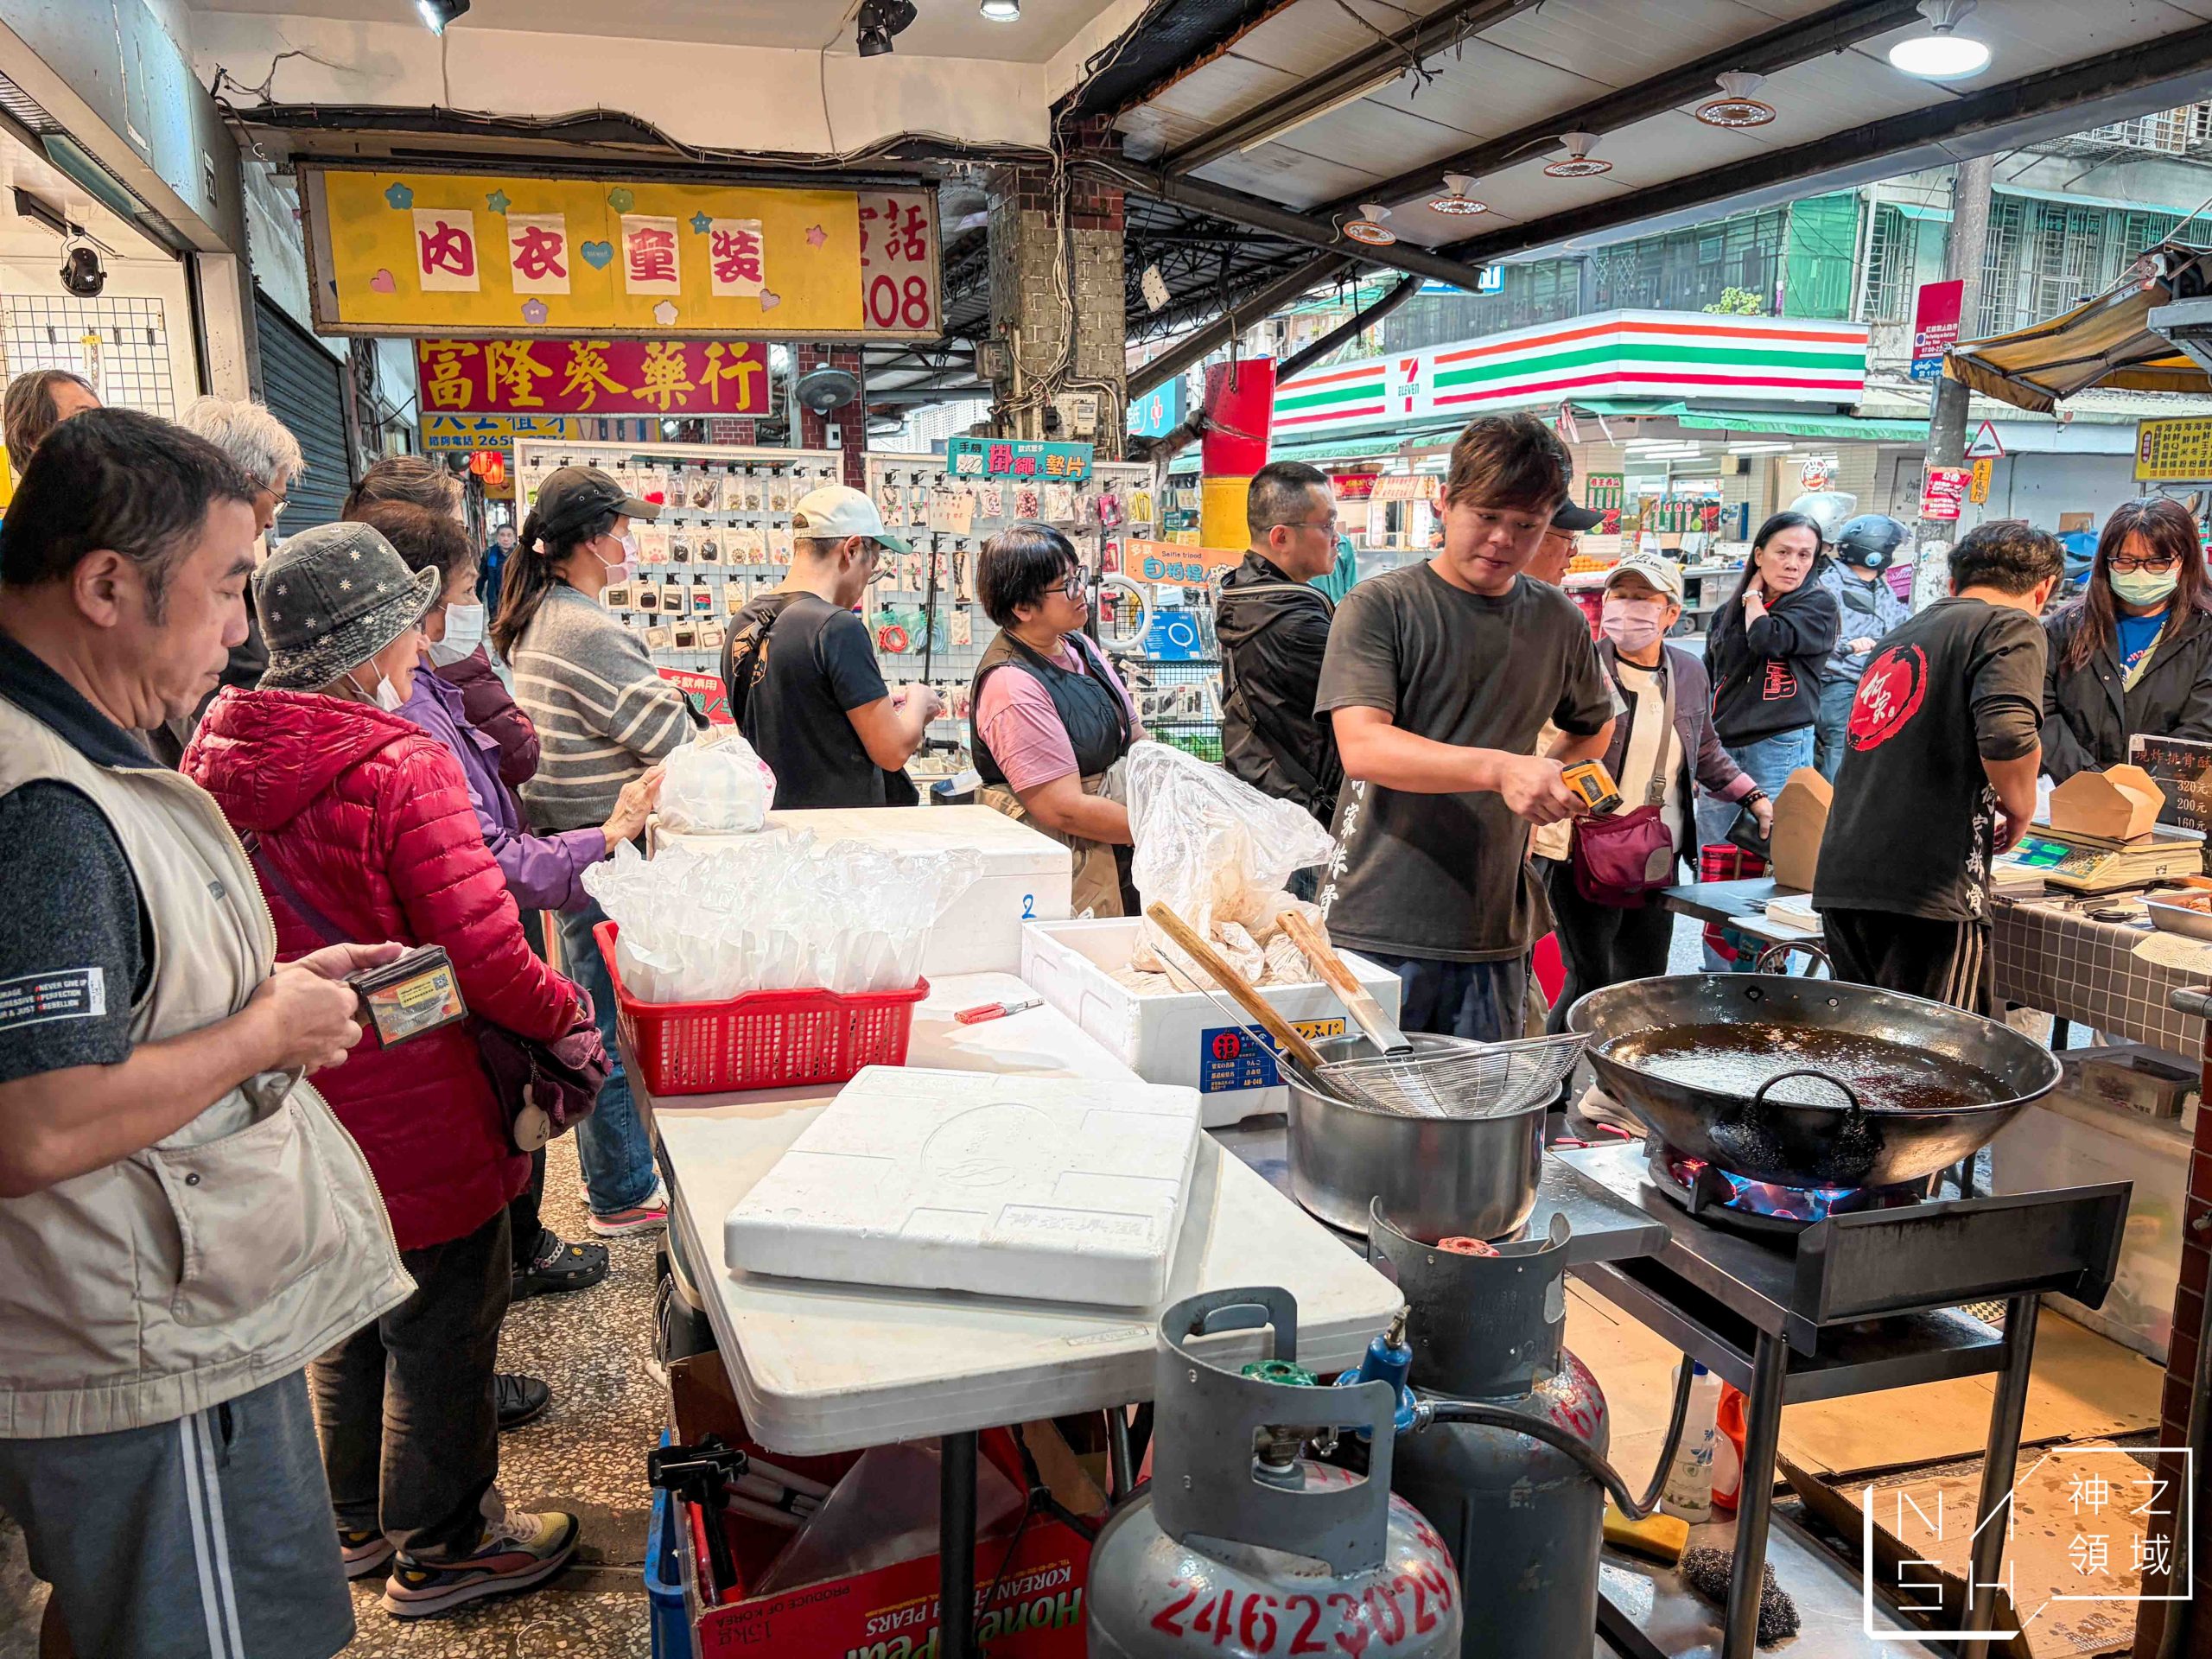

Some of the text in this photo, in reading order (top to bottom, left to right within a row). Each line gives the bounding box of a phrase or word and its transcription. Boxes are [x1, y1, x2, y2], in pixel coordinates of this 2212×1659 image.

[863, 275, 929, 328] 08
[2177, 780, 2209, 795] 320元
[2177, 798, 2208, 813] 200元
[2177, 817, 2208, 831] 160元
[1021, 894, 1036, 919] 2
[998, 1566, 1072, 1600] KOREAN
[766, 1603, 785, 1615] OF
[787, 1585, 850, 1611] PRODUCE
[715, 1608, 763, 1628] KOREA
[864, 1604, 927, 1637] PEARS
[976, 1587, 1083, 1642] Hone
